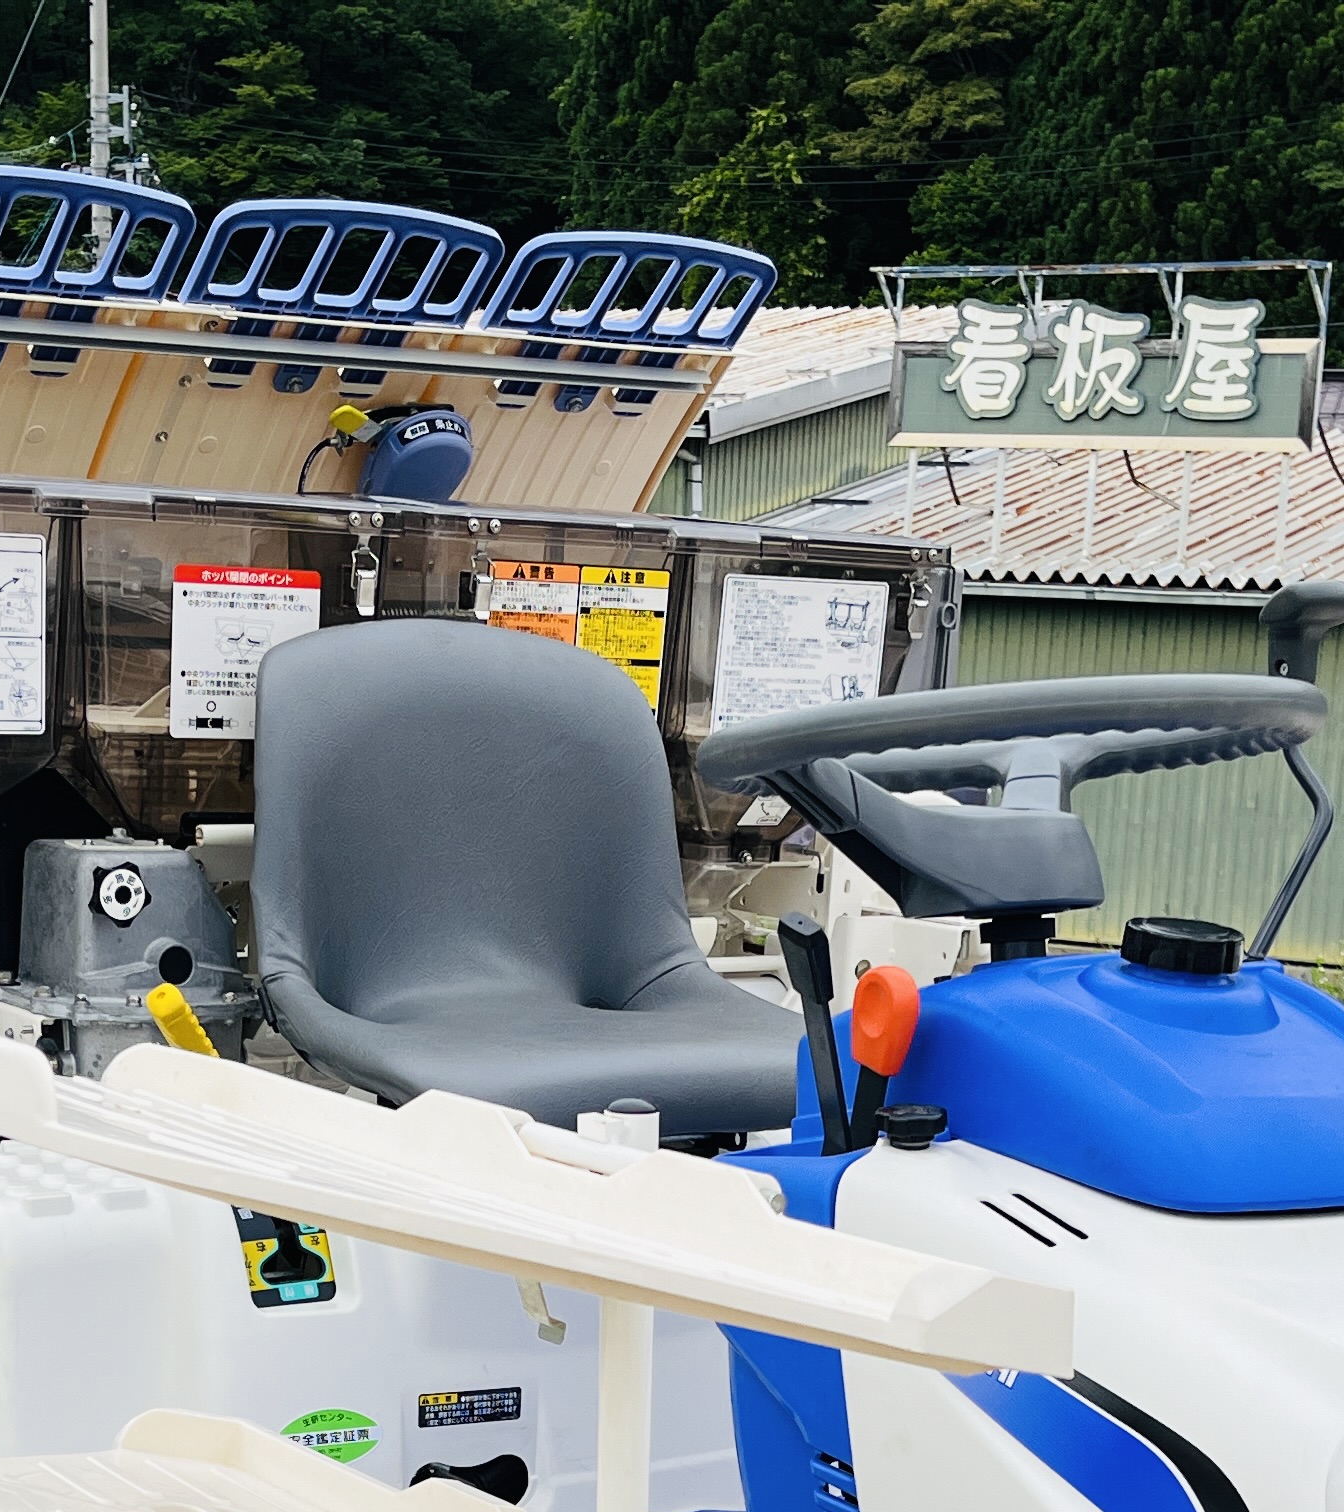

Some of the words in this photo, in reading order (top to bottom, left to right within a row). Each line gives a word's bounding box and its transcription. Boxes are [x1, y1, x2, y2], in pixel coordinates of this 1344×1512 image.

[942, 300, 1262, 416] 看板屋
[201, 570, 294, 586] ホッパ開閉のポイント
[529, 565, 555, 580] 警告
[620, 571, 646, 585] 注意
[302, 1412, 353, 1428] 生研センター
